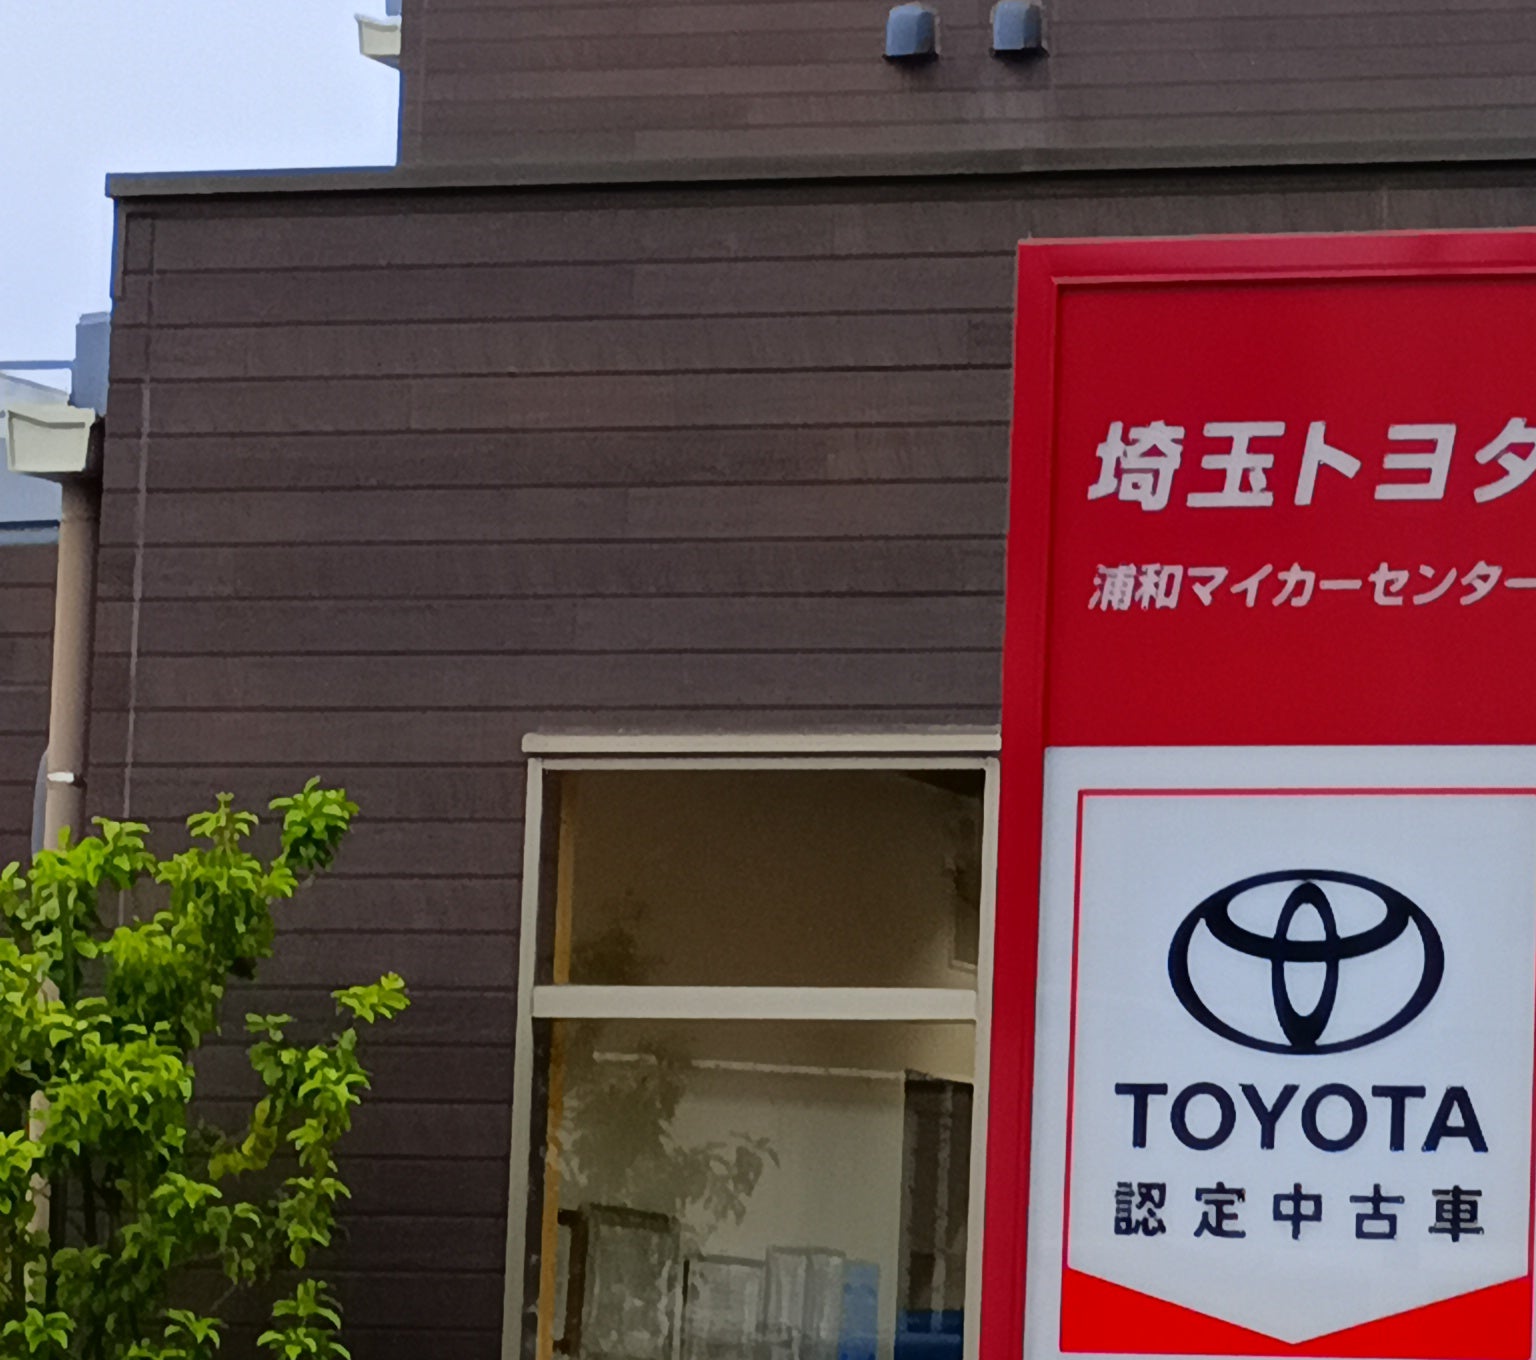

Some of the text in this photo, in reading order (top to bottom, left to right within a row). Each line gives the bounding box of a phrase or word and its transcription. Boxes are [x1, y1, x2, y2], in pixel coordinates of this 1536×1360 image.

[1113, 1081, 1489, 1153] TOYOTA
[1113, 1181, 1485, 1242] 認定中古車
